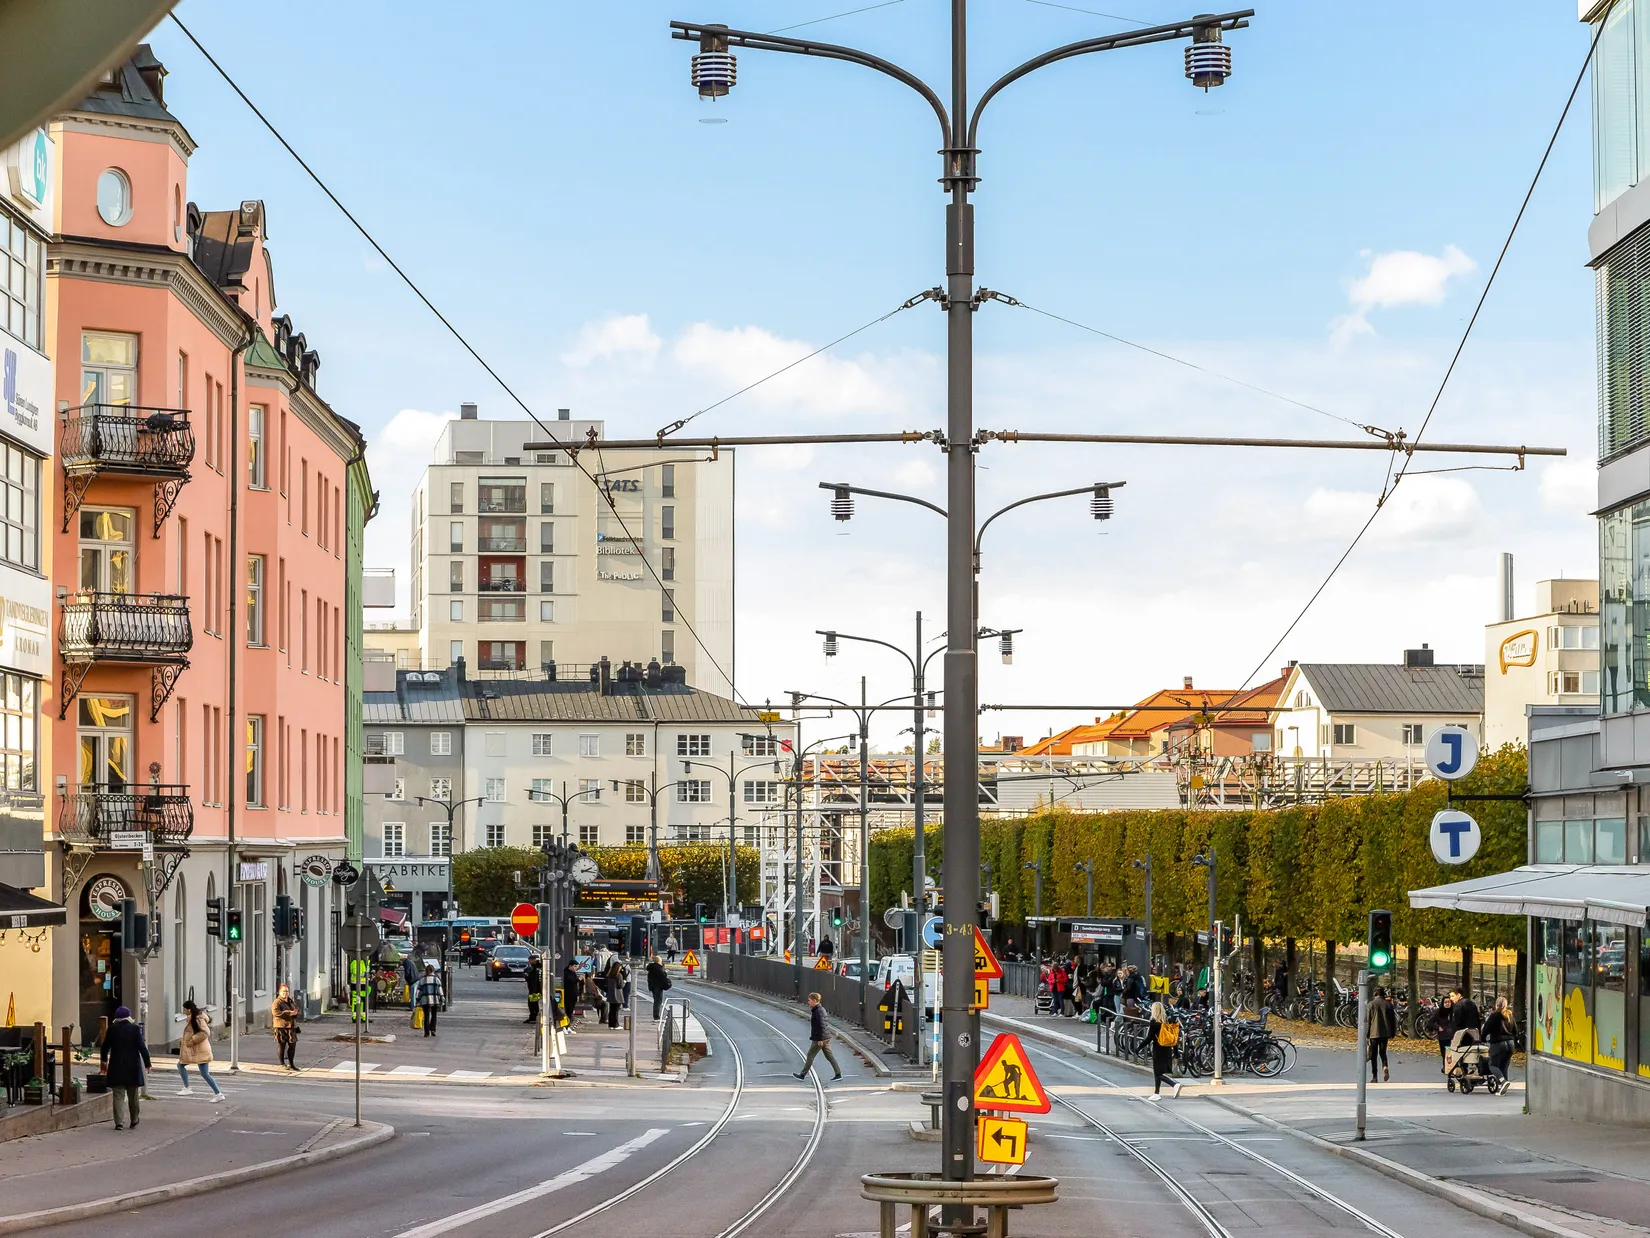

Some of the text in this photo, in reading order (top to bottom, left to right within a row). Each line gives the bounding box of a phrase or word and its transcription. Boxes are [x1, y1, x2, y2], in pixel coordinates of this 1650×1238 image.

[601, 479, 640, 492] SATS
[597, 545, 635, 554] Bibliotek
[1436, 733, 1462, 774] J
[1439, 821, 1471, 857] T
[302, 856, 330, 868] ESPRESSO
[92, 880, 123, 896] ESPRESSO
[946, 923, 973, 936] 3-43
